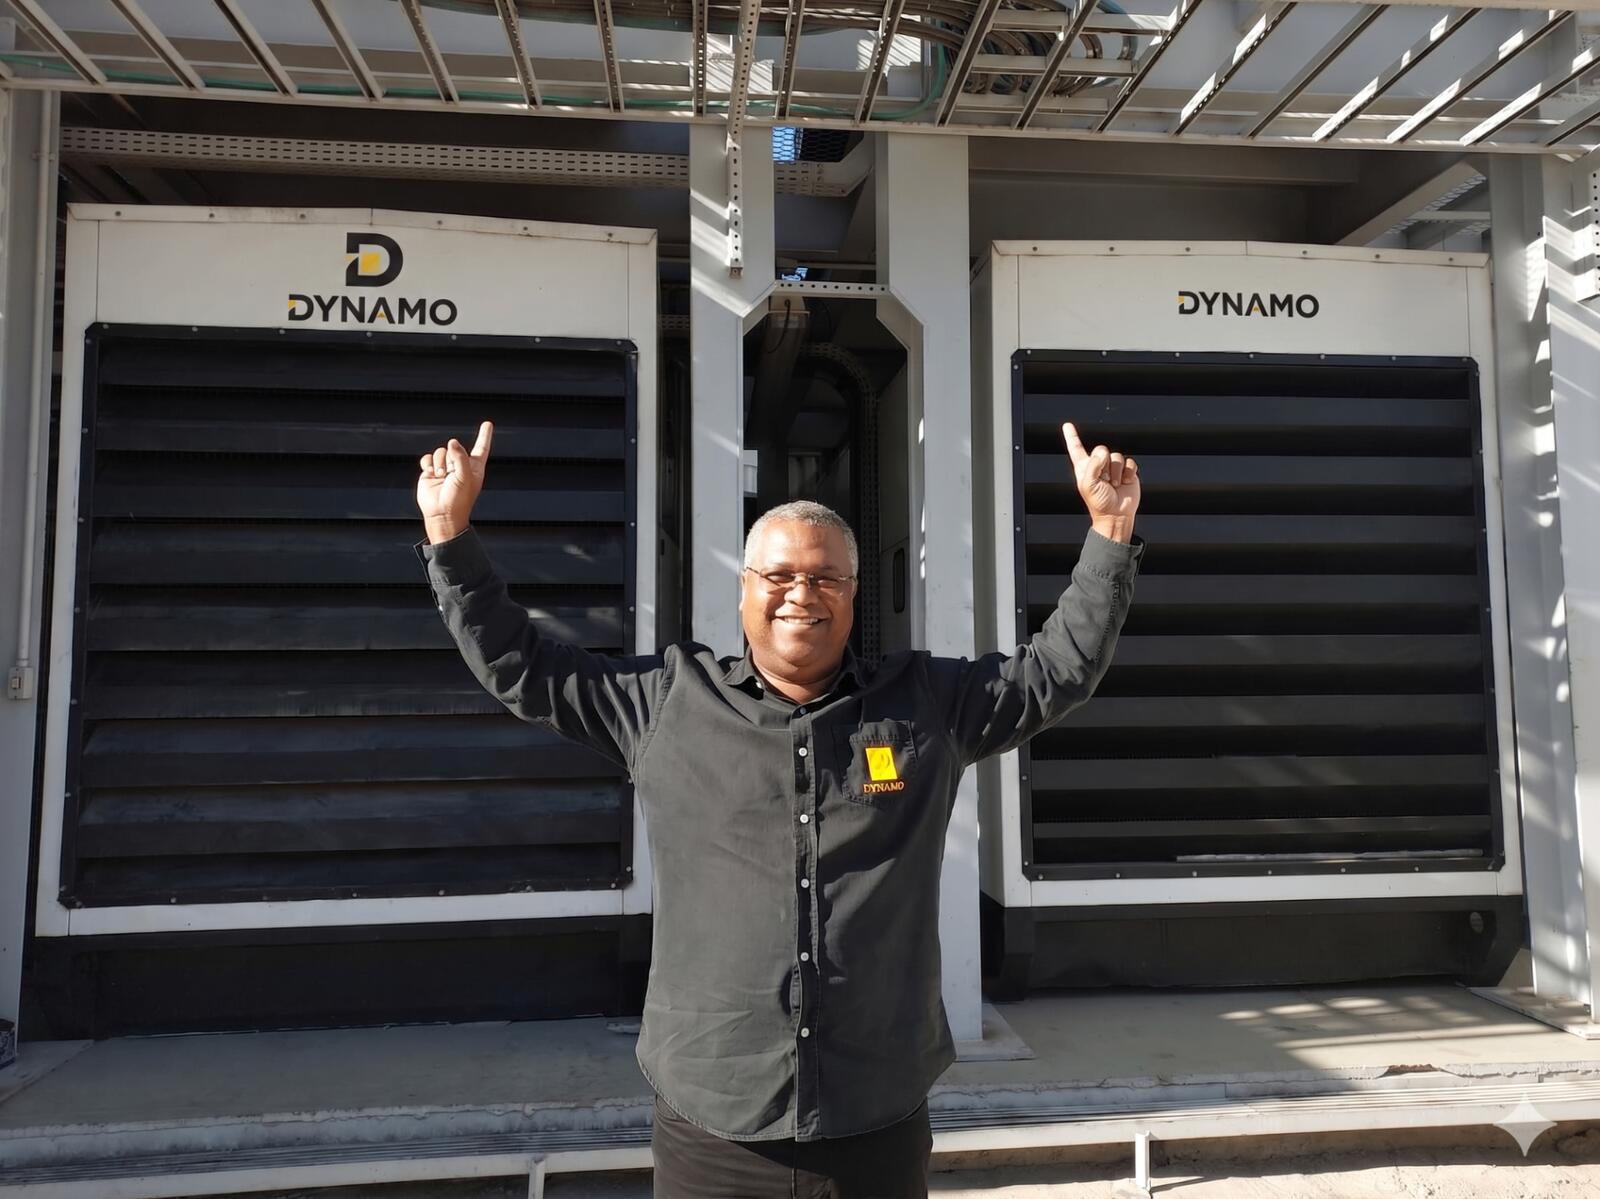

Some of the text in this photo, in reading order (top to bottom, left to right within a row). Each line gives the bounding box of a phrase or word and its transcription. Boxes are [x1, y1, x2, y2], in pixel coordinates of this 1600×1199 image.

[288, 293, 457, 326] DYNAMO
[1178, 291, 1319, 318] DYNAMO
[863, 781, 905, 793] DYNAMO
